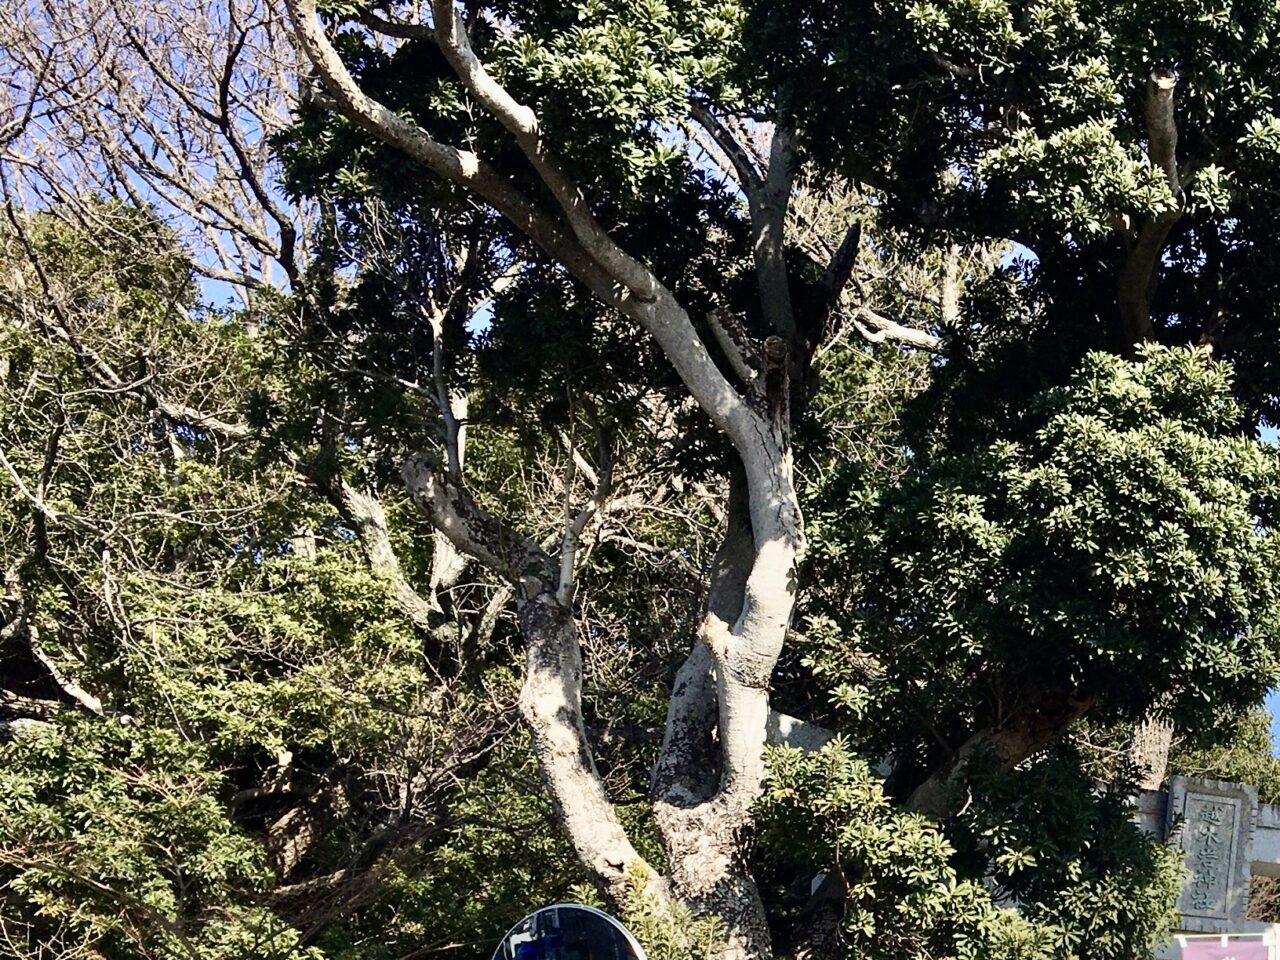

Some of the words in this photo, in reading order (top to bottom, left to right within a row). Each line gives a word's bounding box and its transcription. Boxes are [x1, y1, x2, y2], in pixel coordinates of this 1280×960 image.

[1190, 803, 1223, 911] 越木岩神社
